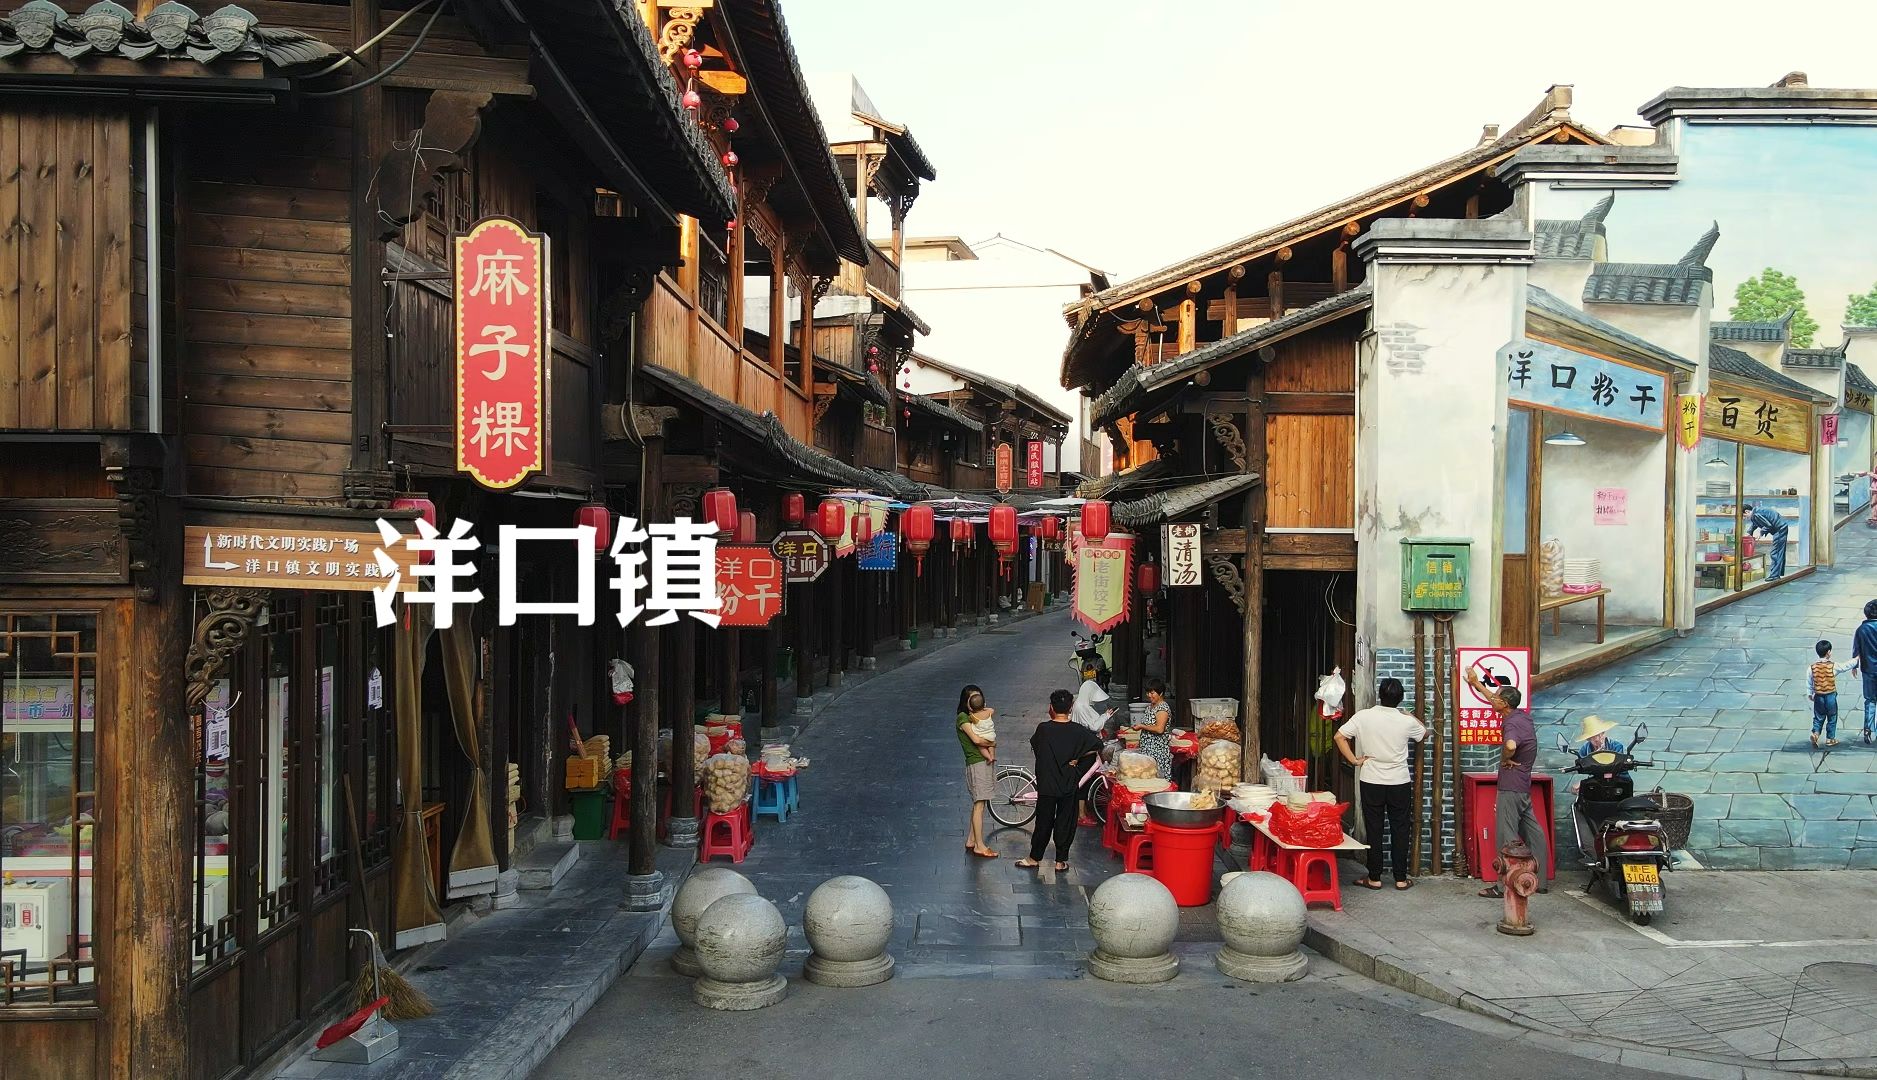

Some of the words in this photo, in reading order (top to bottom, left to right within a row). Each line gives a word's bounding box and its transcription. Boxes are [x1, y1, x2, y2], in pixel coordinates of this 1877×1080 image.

[469, 249, 530, 458] 麻子粿
[1508, 351, 1656, 415] 洋口粉干
[1682, 401, 1696, 438] 粉干
[1718, 396, 1779, 439] 百货
[1824, 416, 1834, 443] 百货
[1030, 443, 1040, 486] 便民服务站
[216, 533, 360, 554] 新时代文明实践广场
[1172, 524, 1196, 537] 老街
[778, 541, 818, 557] 洋口
[1172, 539, 1198, 585] 清汤
[245, 558, 399, 579] 洋口镇文明实践
[715, 556, 775, 580] 洋口
[1425, 560, 1453, 574] 信箱
[715, 581, 780, 616] 粉干
[1093, 560, 1109, 616] 老街饺子
[1460, 719, 1503, 728] 电动车禁
